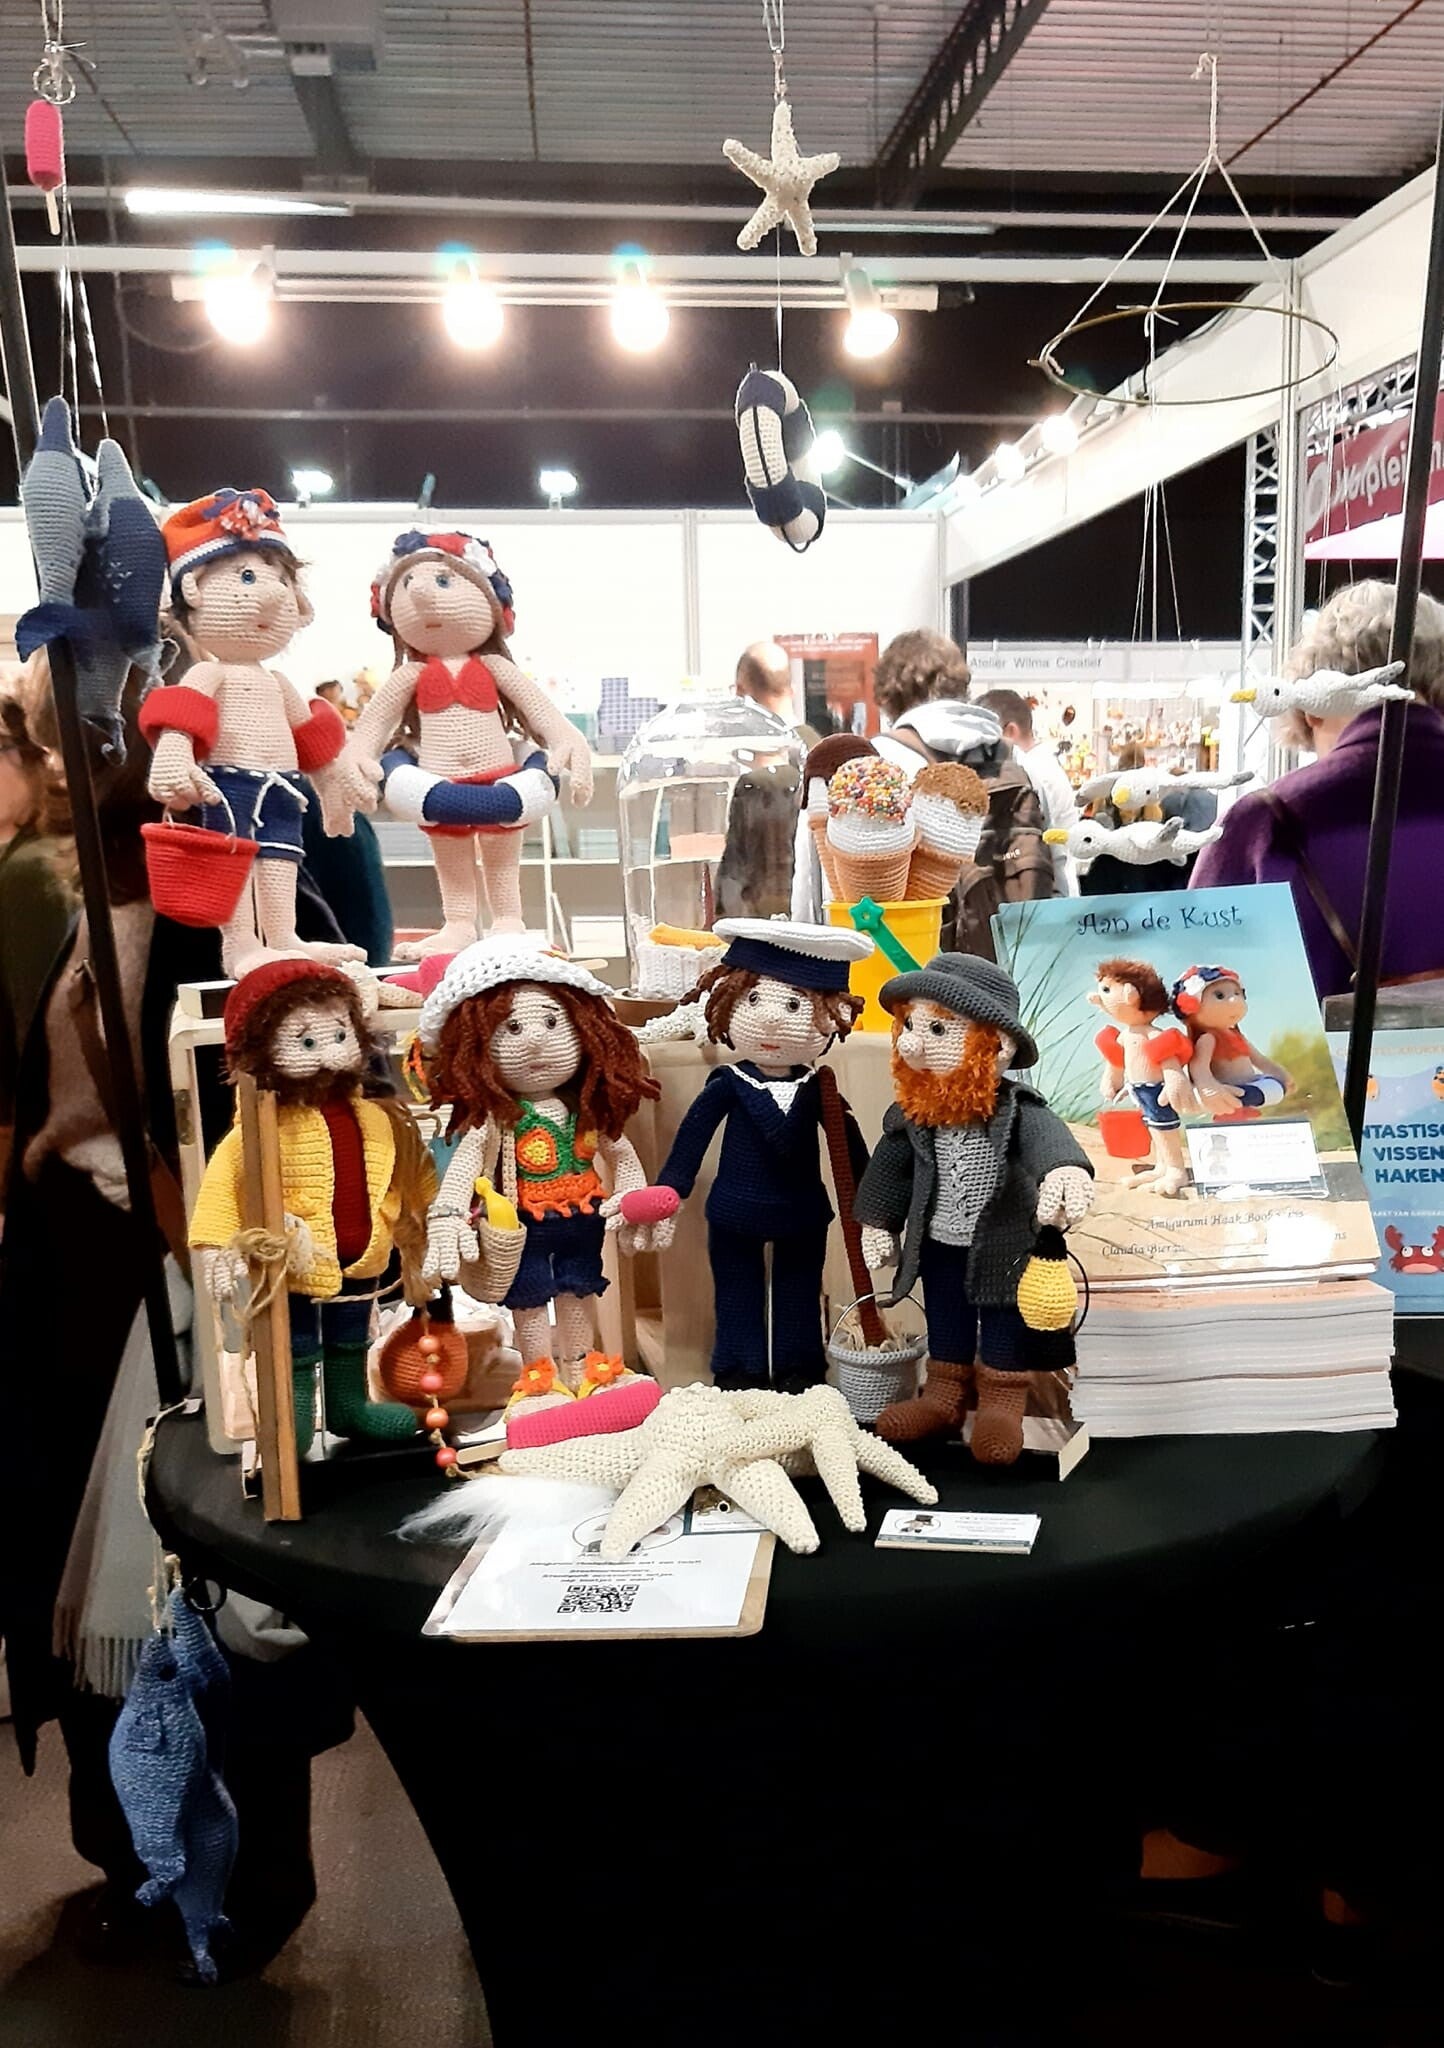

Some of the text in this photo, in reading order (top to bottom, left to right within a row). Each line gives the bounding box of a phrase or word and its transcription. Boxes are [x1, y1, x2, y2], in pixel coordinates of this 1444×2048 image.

[970, 657, 1103, 668] Atelier Wilma Creatief
[1078, 905, 1243, 936] Aan de Kust
[1373, 1145, 1444, 1161] VISSEN
[1375, 1167, 1444, 1183] HAKEN
[1101, 1242, 1146, 1257] Claudia
